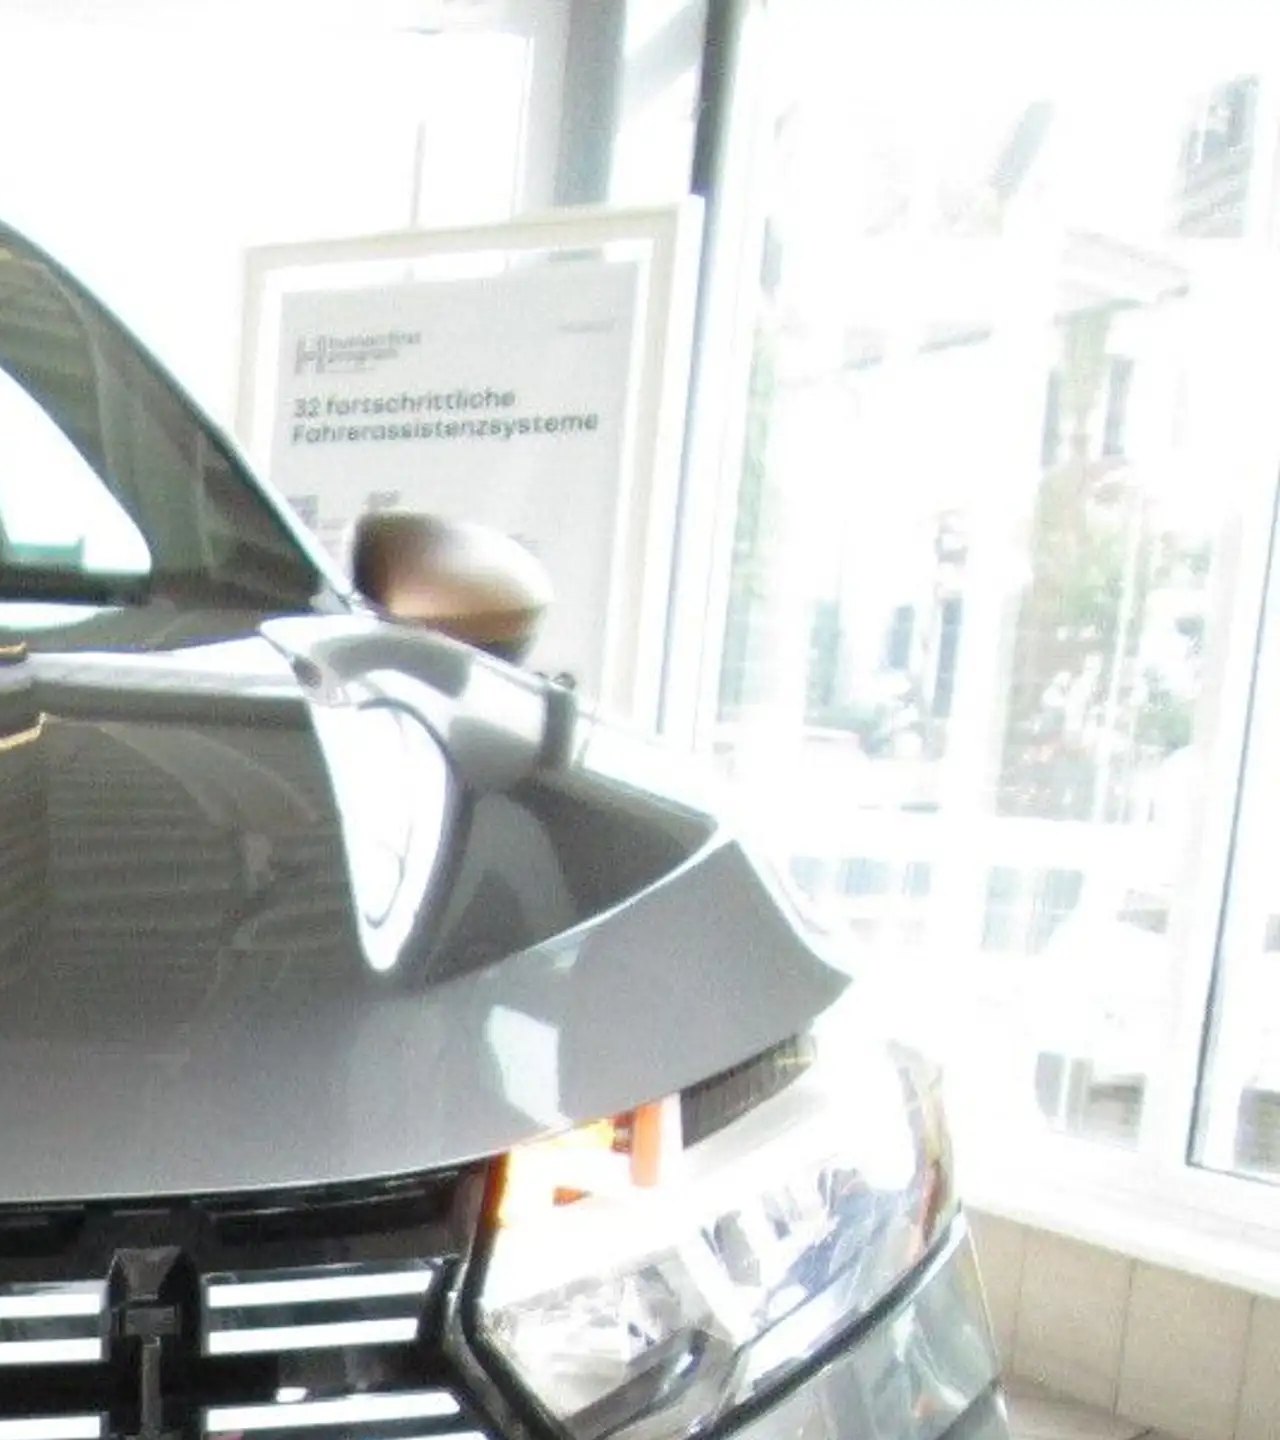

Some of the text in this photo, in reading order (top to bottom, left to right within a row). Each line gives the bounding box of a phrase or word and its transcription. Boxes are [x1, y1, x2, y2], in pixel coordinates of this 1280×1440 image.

[293, 386, 516, 418] 32 fortschrittliche
[291, 411, 600, 445] Fahrerassistenzsysteme
